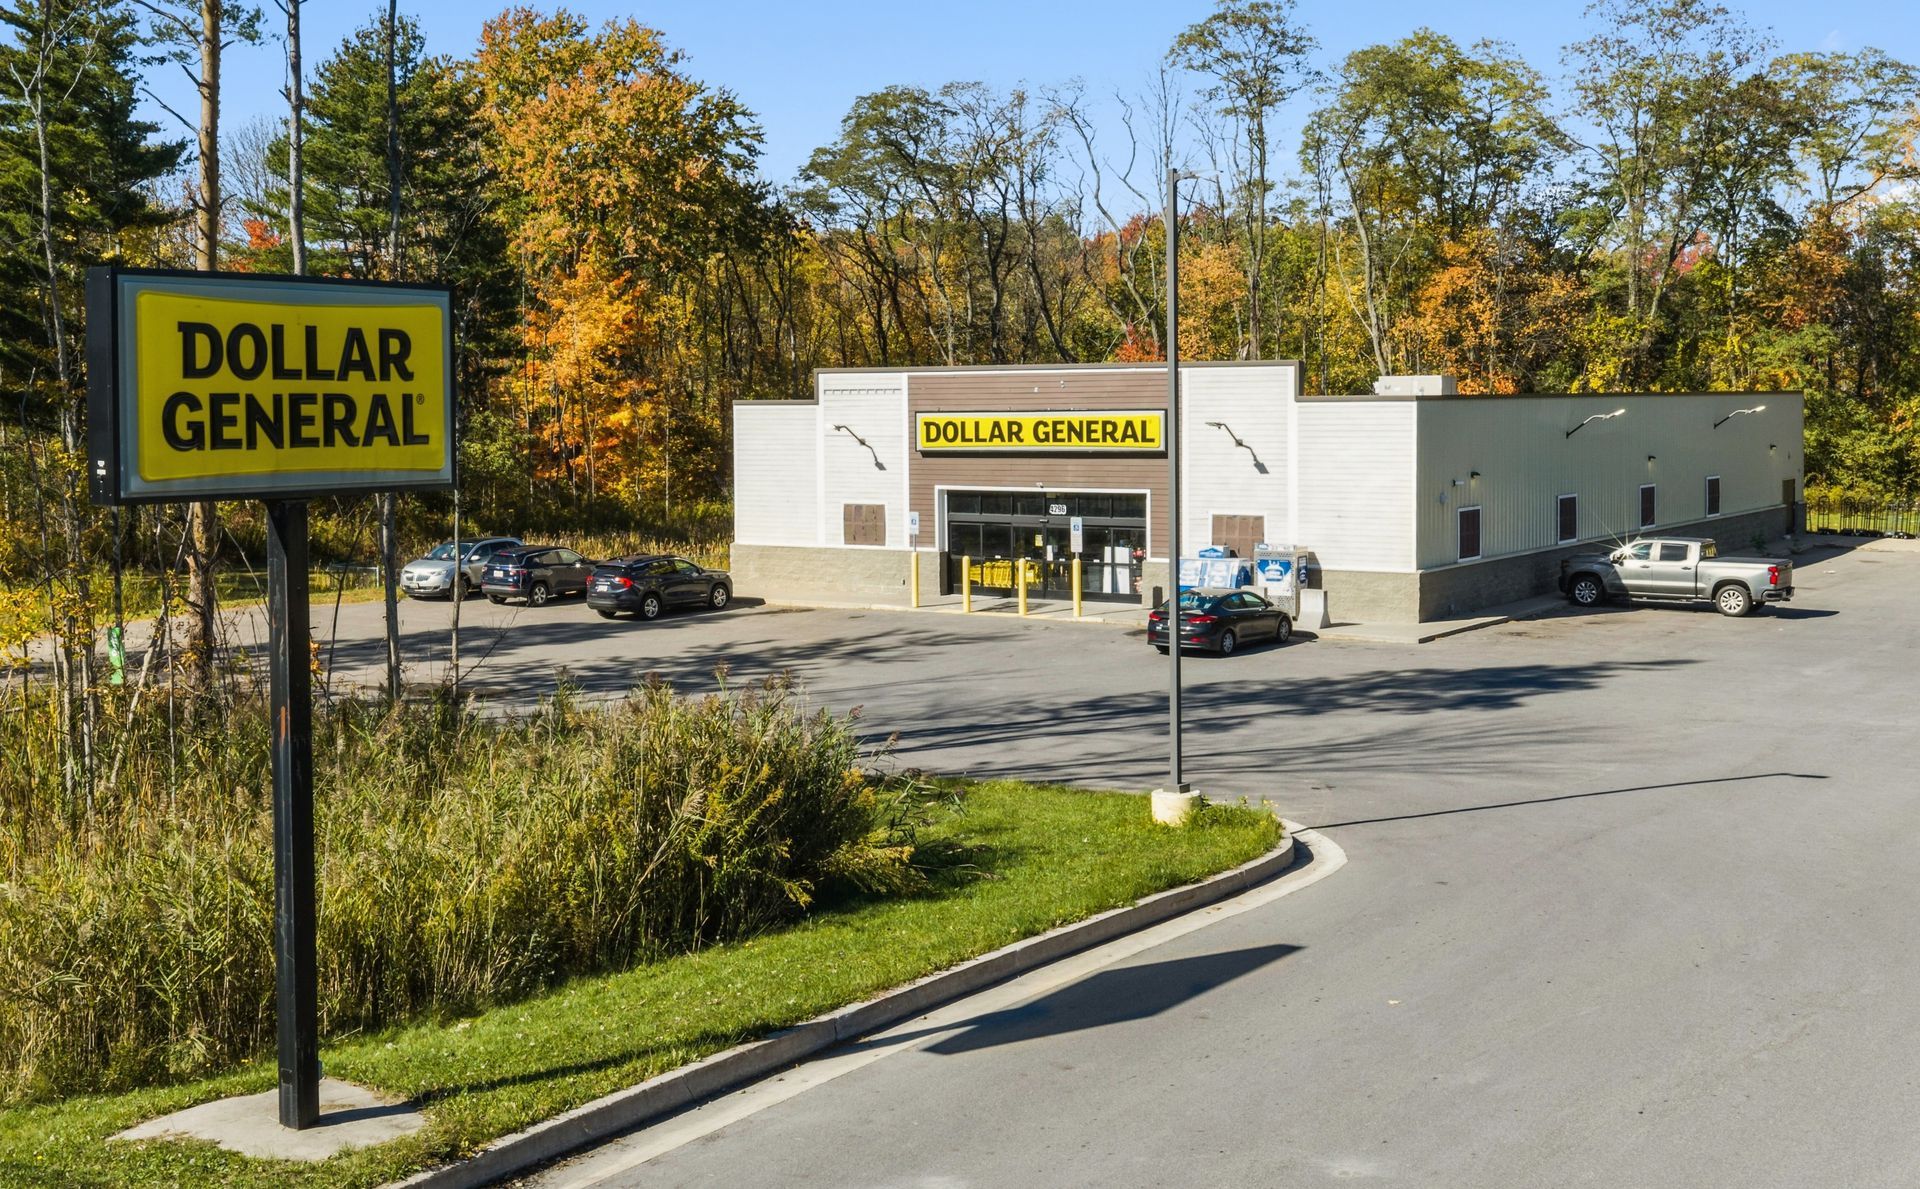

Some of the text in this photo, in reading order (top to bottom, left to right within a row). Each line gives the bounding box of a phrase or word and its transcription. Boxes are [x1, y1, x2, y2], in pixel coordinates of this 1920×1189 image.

[178, 321, 414, 382] DOLLAR
[923, 420, 1155, 443] DOLLAR GENERAL
